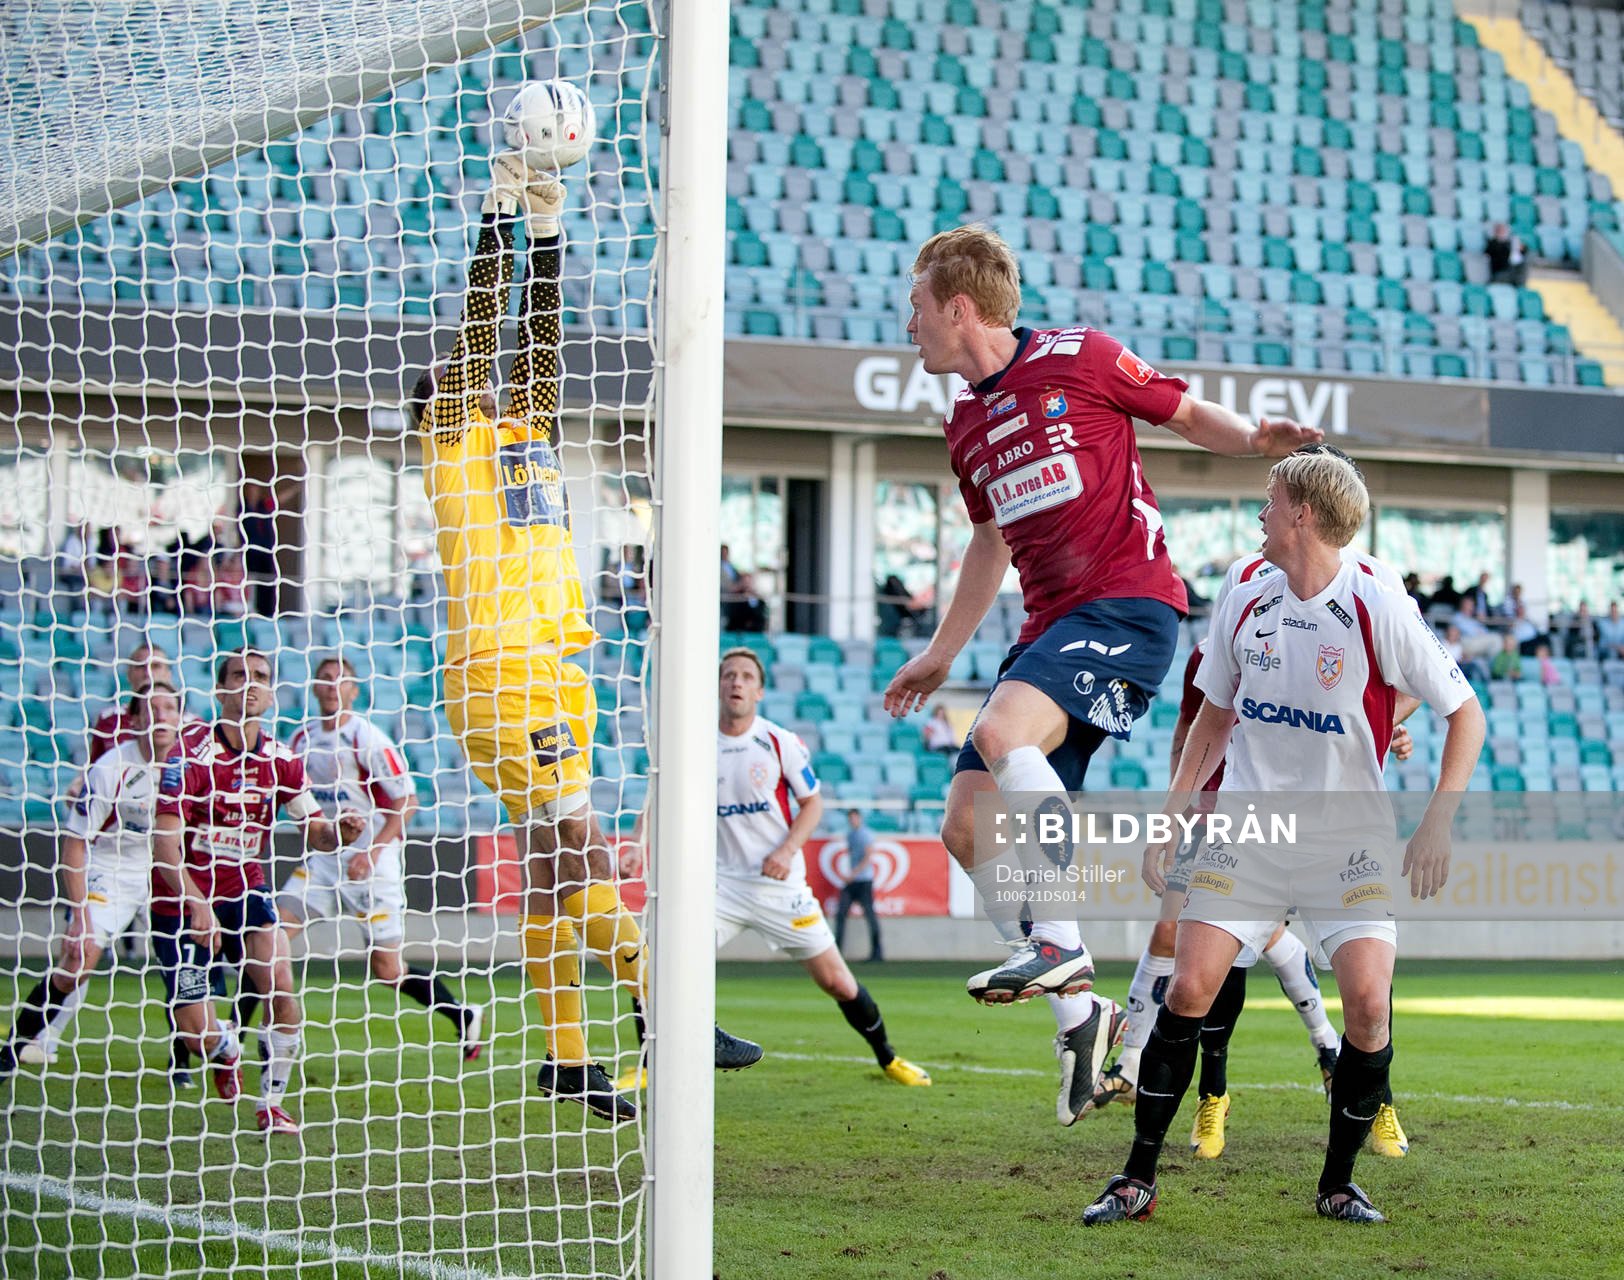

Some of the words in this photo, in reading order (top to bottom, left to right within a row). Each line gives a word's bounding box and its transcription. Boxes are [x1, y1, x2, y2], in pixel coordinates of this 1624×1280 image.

[1041, 462, 1067, 487] AB
[1281, 617, 1318, 632] stadium
[1244, 648, 1281, 672] Telge
[1241, 697, 1345, 735] SCANIA
[1200, 851, 1239, 869] ALCON
[1339, 860, 1382, 882] FALCO
[1408, 851, 1624, 907] allenst
[183, 943, 196, 965] 7
